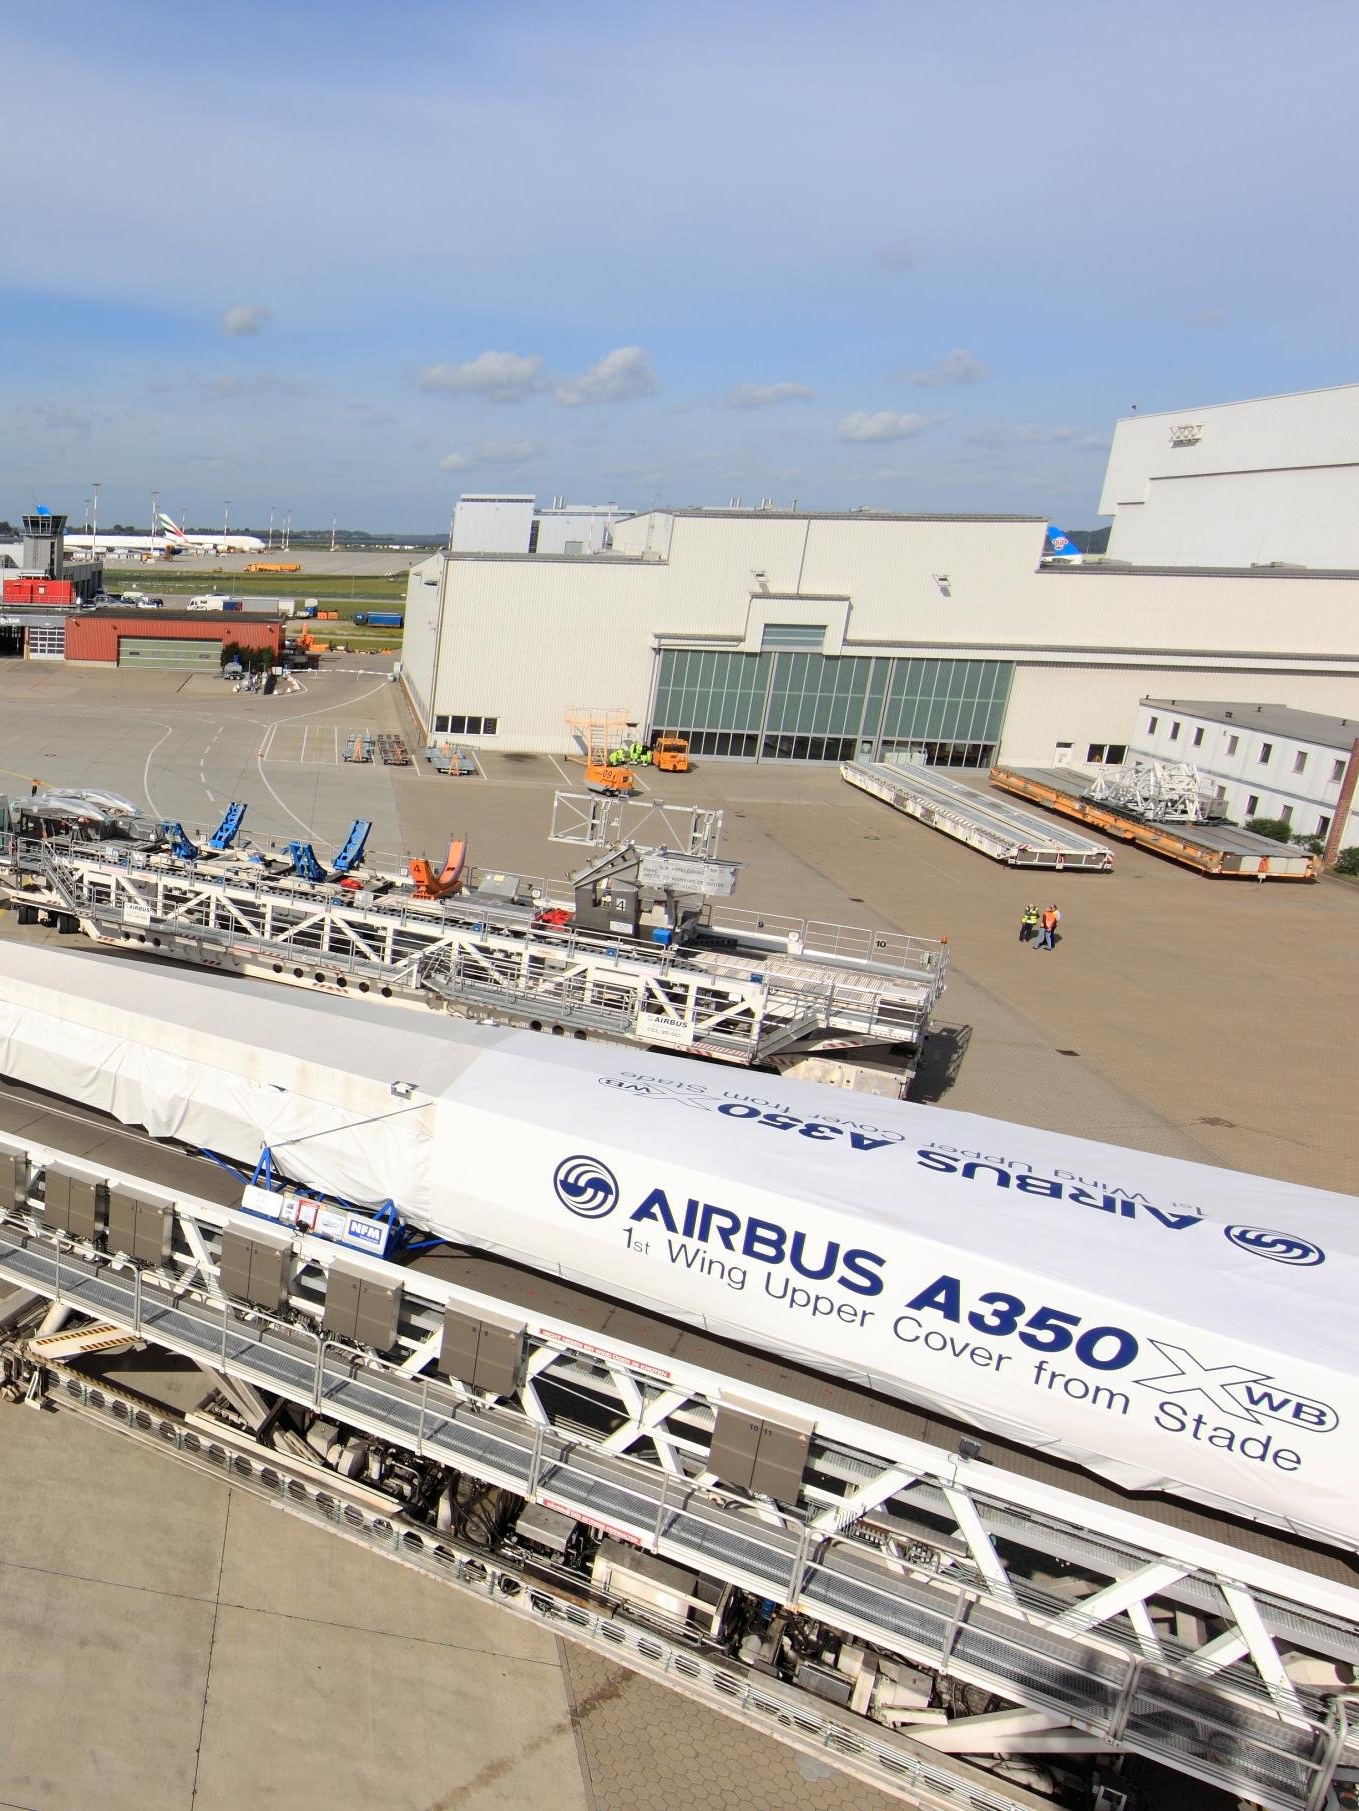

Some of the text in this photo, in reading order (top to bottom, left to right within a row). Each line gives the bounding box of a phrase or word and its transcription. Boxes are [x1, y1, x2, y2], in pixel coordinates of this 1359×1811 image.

[602, 769, 613, 779] 09
[413, 864, 421, 874] 4
[616, 900, 626, 911] 4
[875, 940, 887, 949] 10
[653, 1016, 688, 1028] AIRBUS
[718, 1103, 896, 1151] A350
[620, 1071, 1211, 1217] 1st Wing Upper Cover from Stade
[917, 1149, 1204, 1231] AIRBUS
[351, 1221, 380, 1238] NFM
[630, 1188, 886, 1296] AIRBUS
[906, 1274, 1139, 1371] A350
[622, 1227, 1302, 1471] 1st Wing Upper Cover from Stade
[596, 1347, 612, 1359] WIND
[640, 1363, 667, 1377] KNOTEN
[749, 1424, 759, 1432] 10
